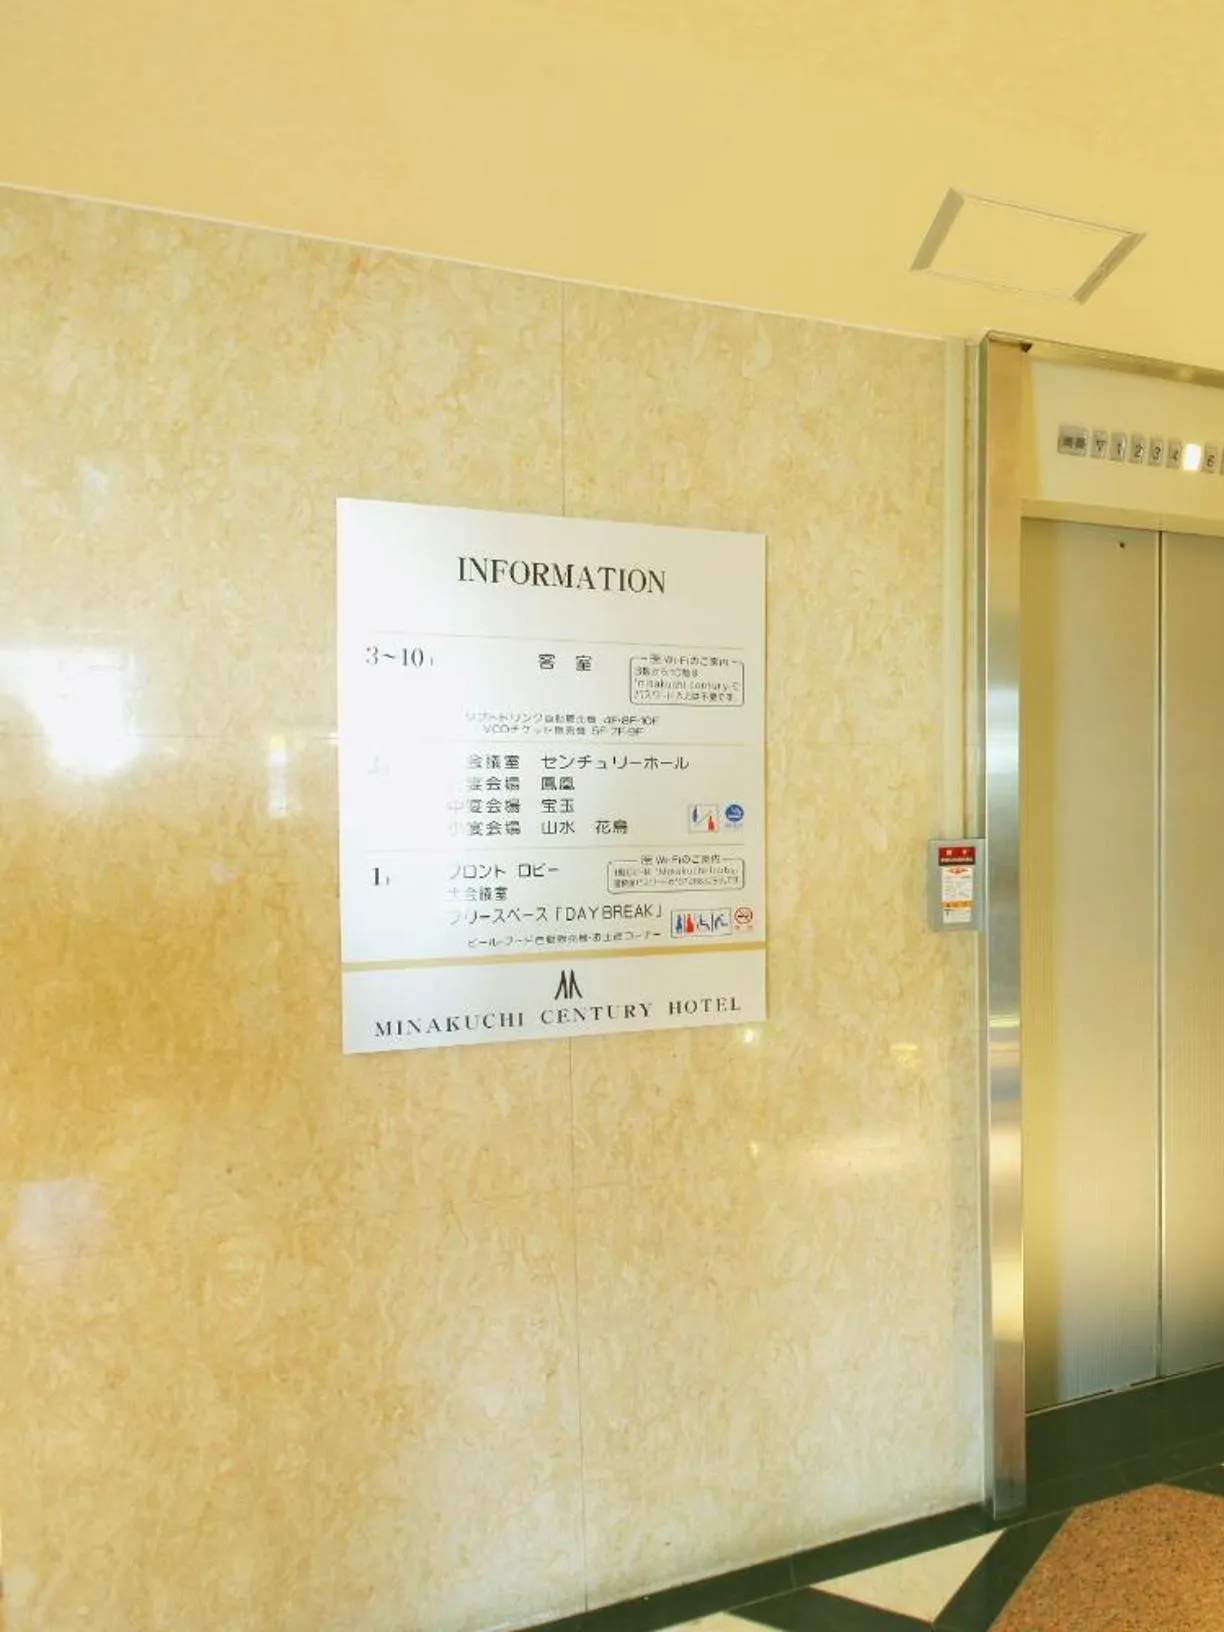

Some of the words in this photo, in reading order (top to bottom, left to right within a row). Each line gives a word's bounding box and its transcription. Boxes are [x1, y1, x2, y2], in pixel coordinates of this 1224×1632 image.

[457, 555, 666, 594] INFORMATION
[540, 755, 690, 770] センチュリーホール
[540, 798, 576, 814] 宝玉
[540, 820, 576, 835] 山水
[595, 819, 629, 835] 花鳥
[517, 862, 561, 878] ロビー
[375, 1011, 525, 1038] MINAKUCHI
[540, 1001, 654, 1026] CENTURY
[668, 997, 741, 1016] HOTEL
